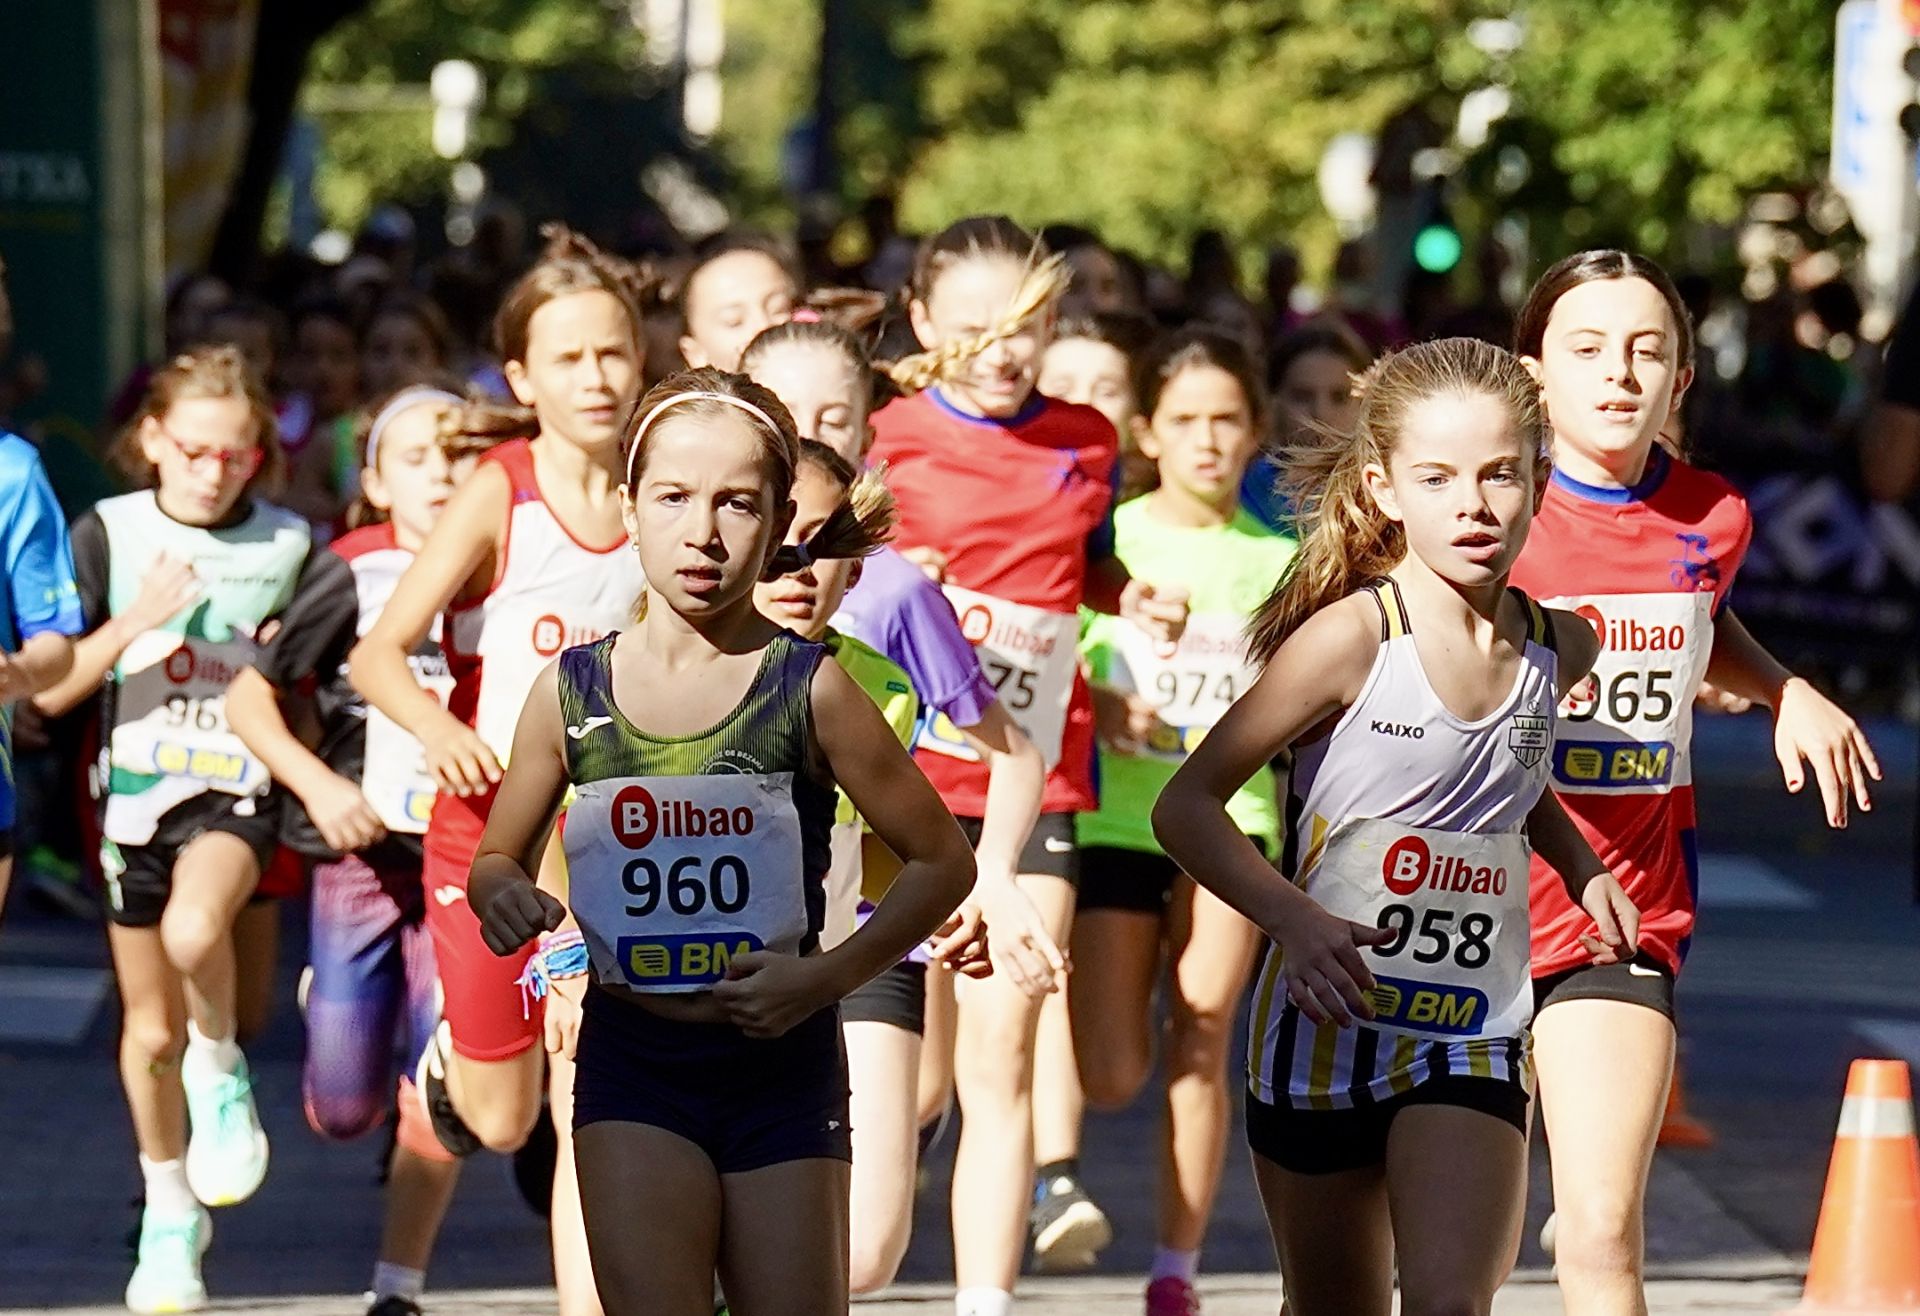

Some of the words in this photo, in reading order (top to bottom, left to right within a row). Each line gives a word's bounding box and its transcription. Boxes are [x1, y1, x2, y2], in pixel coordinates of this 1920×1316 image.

[1588, 618, 1686, 652] ilbao
[988, 661, 1039, 709] 75
[1156, 670, 1236, 707] 974
[166, 692, 232, 732] 96
[1370, 720, 1424, 739] KAIXO
[1610, 747, 1668, 780] BM
[619, 798, 755, 839] Bilbao
[620, 855, 751, 917] 960
[1390, 847, 1508, 896] Bilbao
[1371, 903, 1494, 970] 958
[680, 940, 752, 977] BM
[1405, 990, 1478, 1029] BM
